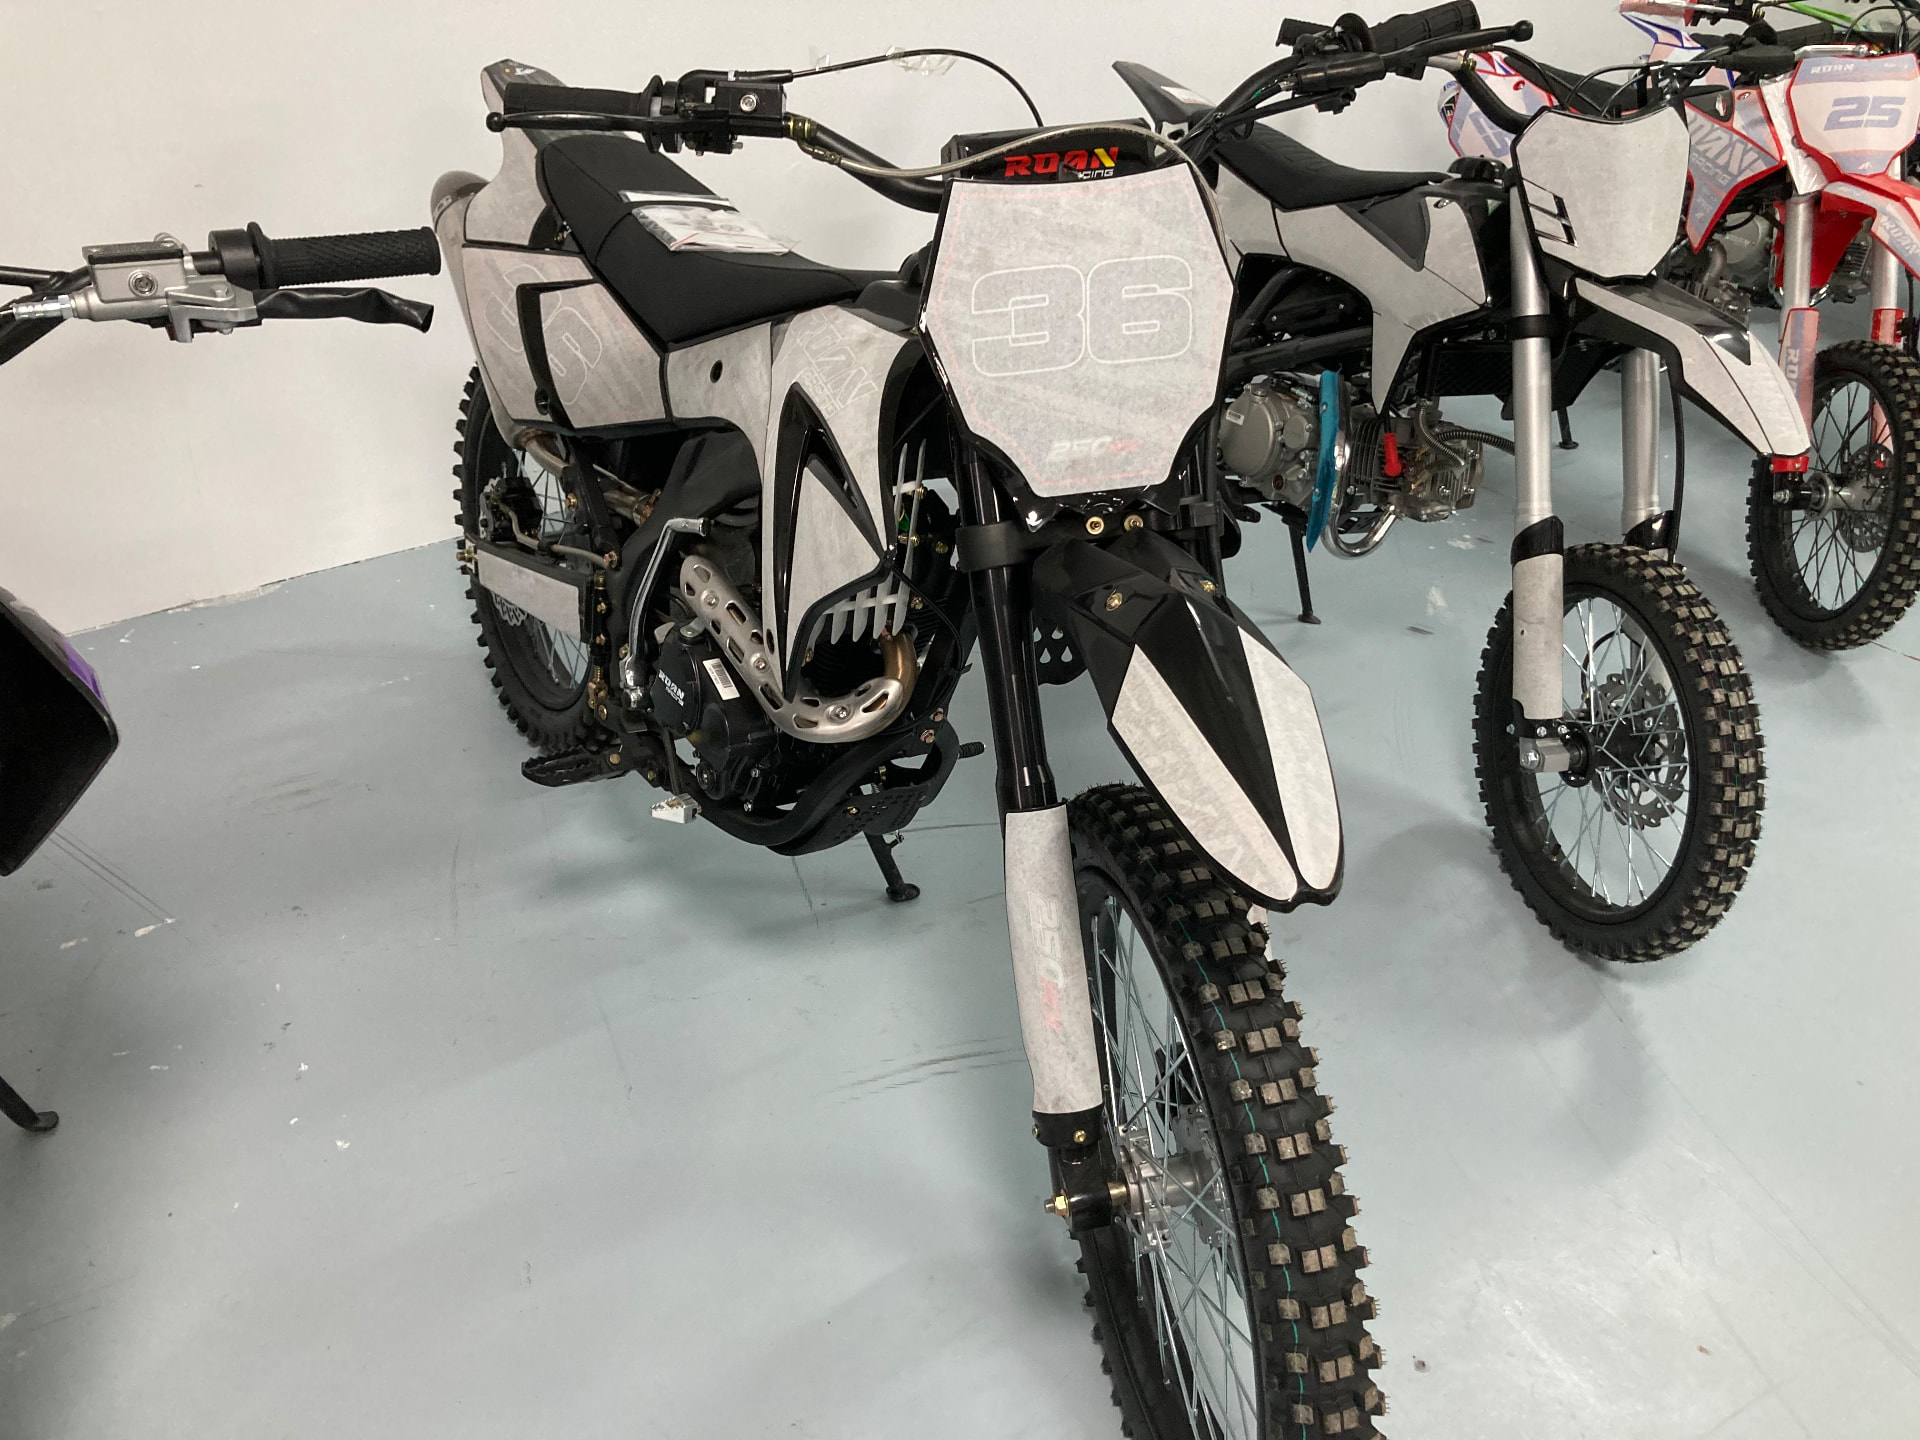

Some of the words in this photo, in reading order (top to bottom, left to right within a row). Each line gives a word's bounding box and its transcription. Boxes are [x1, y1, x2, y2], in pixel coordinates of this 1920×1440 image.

[1823, 95, 1907, 131] 25
[1004, 146, 1119, 177] ROAN
[1079, 168, 1115, 180] CING
[971, 254, 1193, 378] 36
